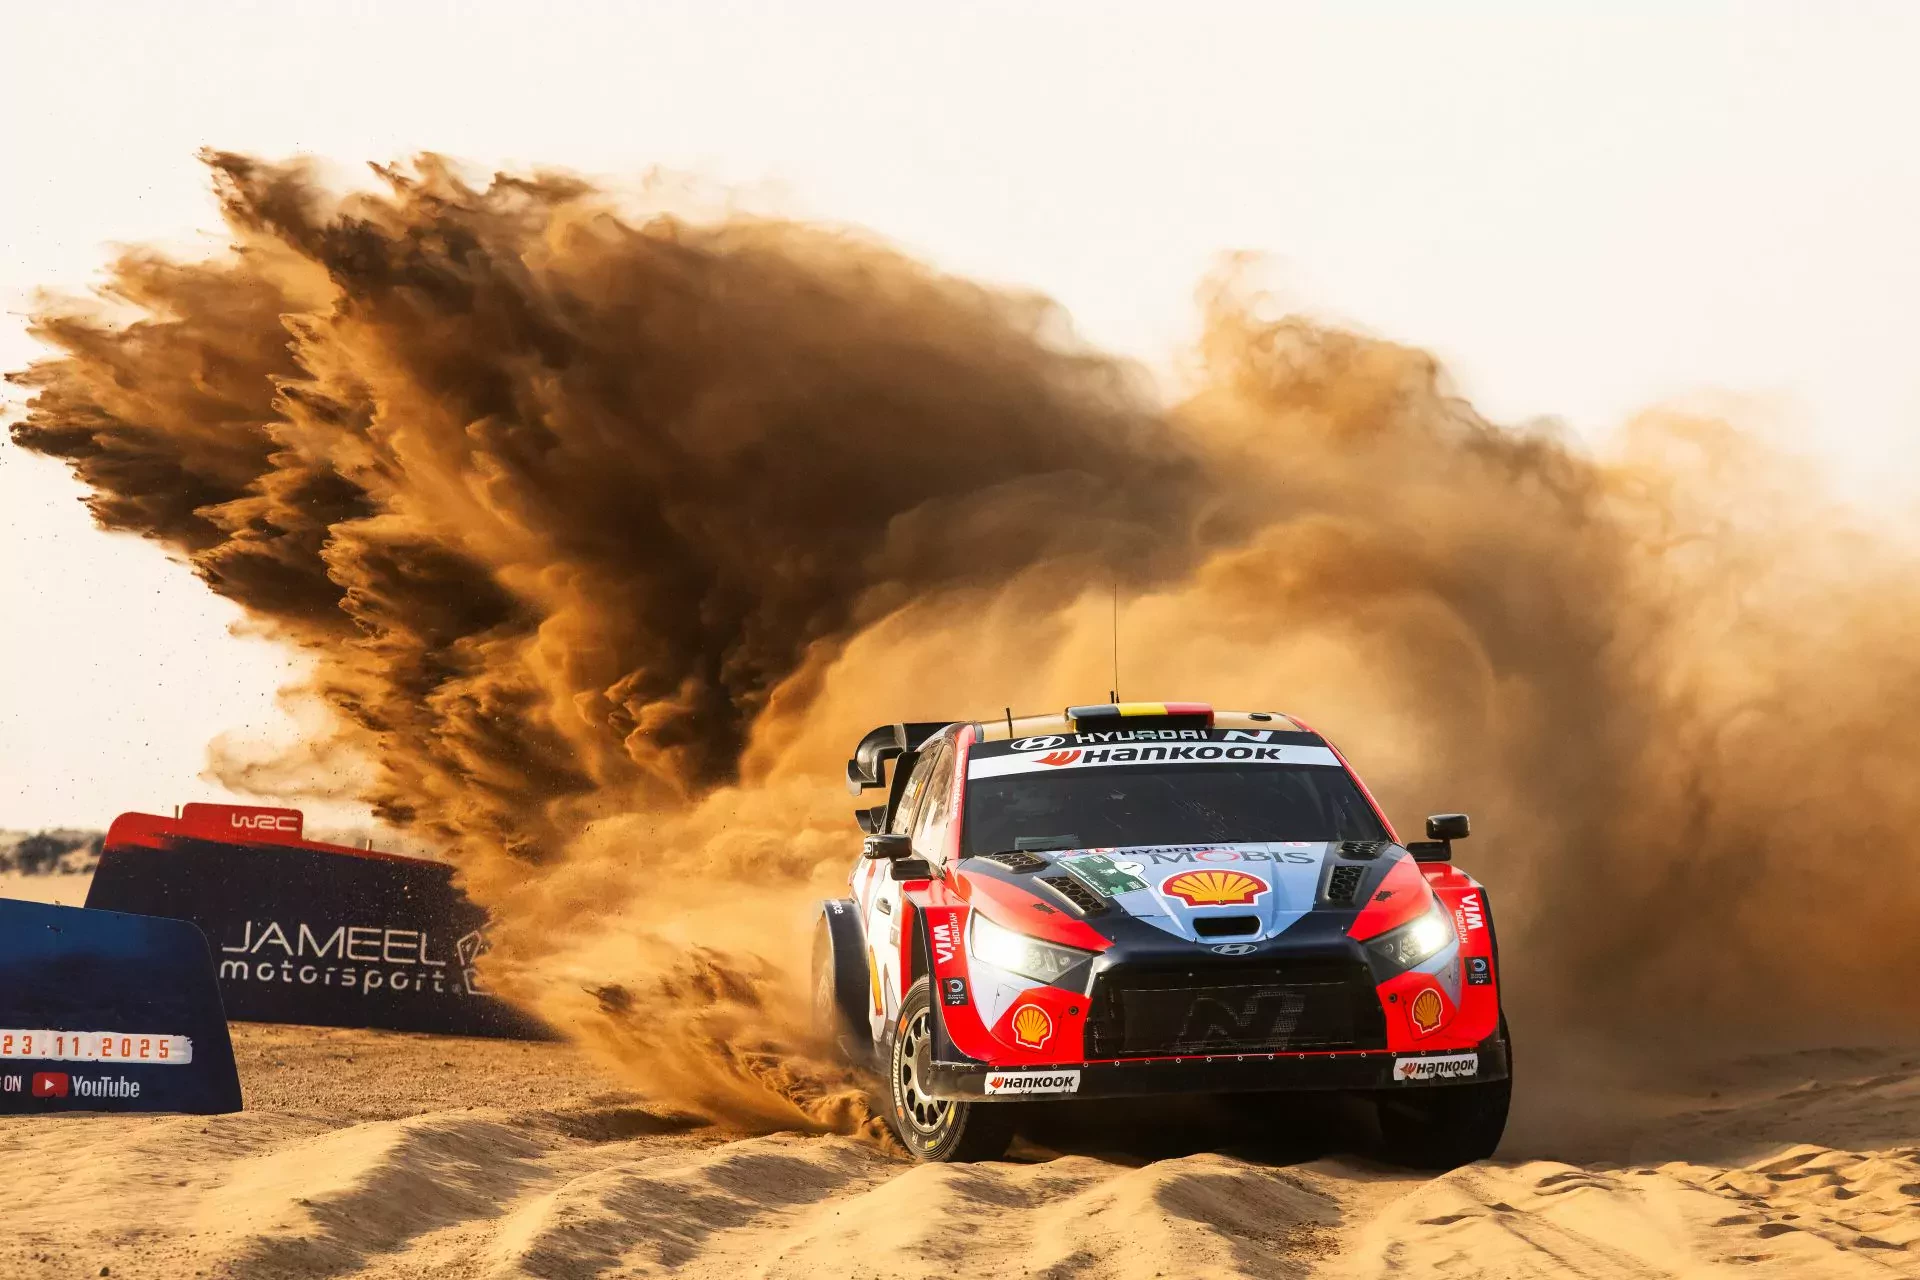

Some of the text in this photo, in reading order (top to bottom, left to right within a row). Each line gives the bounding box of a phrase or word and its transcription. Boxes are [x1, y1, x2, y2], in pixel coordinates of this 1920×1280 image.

[1076, 729, 1208, 744] HYUNDAI
[232, 813, 298, 831] WRC
[1149, 850, 1315, 864] MOBIS
[949, 912, 960, 945] HYUNDAI
[1456, 909, 1468, 943] HYUNDAI
[222, 921, 446, 966] JAMEEL
[220, 959, 445, 995] motorsport
[4, 1035, 169, 1059] 23.11.2025
[4, 1075, 22, 1092] ON
[73, 1076, 140, 1098] YouTube
